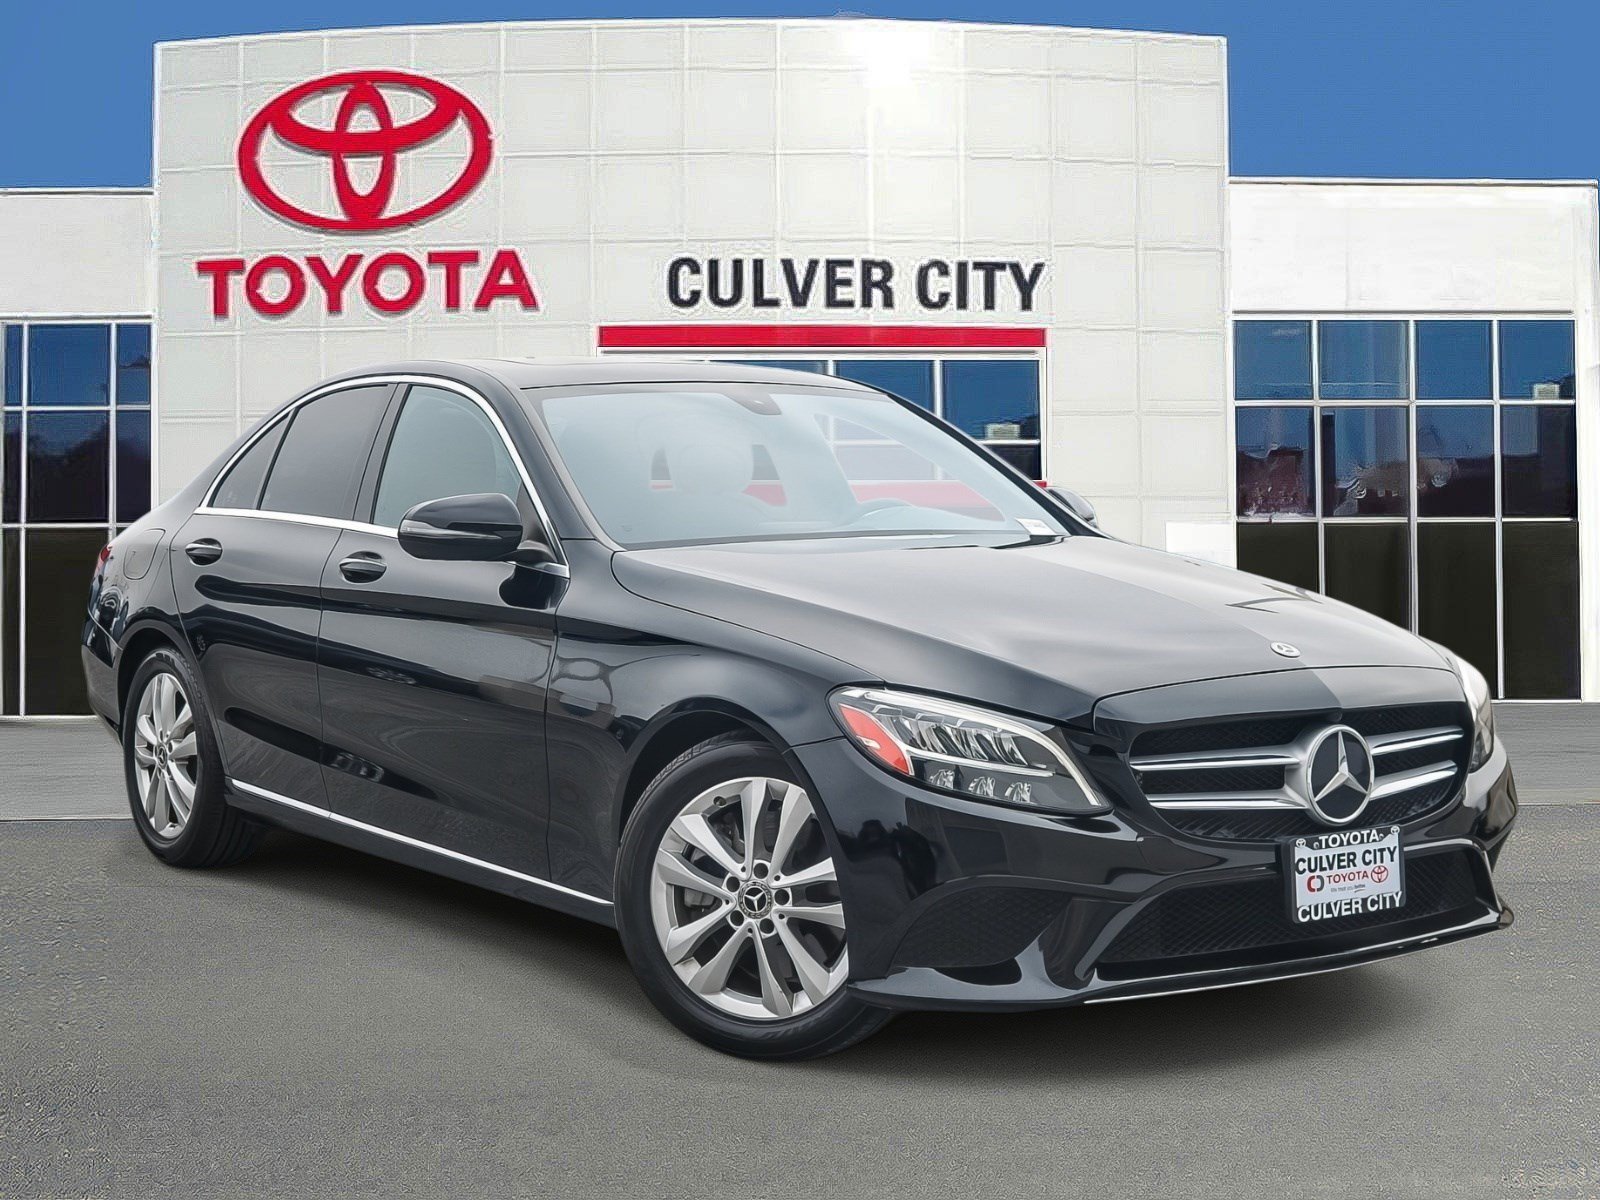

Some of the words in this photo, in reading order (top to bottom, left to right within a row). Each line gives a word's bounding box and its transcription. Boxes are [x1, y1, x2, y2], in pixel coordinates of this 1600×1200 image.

[196, 249, 540, 318] TOYOTA
[667, 256, 895, 309] CULVER
[915, 258, 1046, 311] CITY
[1319, 829, 1380, 849] TOYOTA
[1295, 851, 1357, 875] CULVER
[1361, 845, 1397, 866] CITY
[1326, 870, 1369, 884] TOYOTA
[1297, 898, 1363, 922] CULVER
[1367, 891, 1402, 912] CITY
